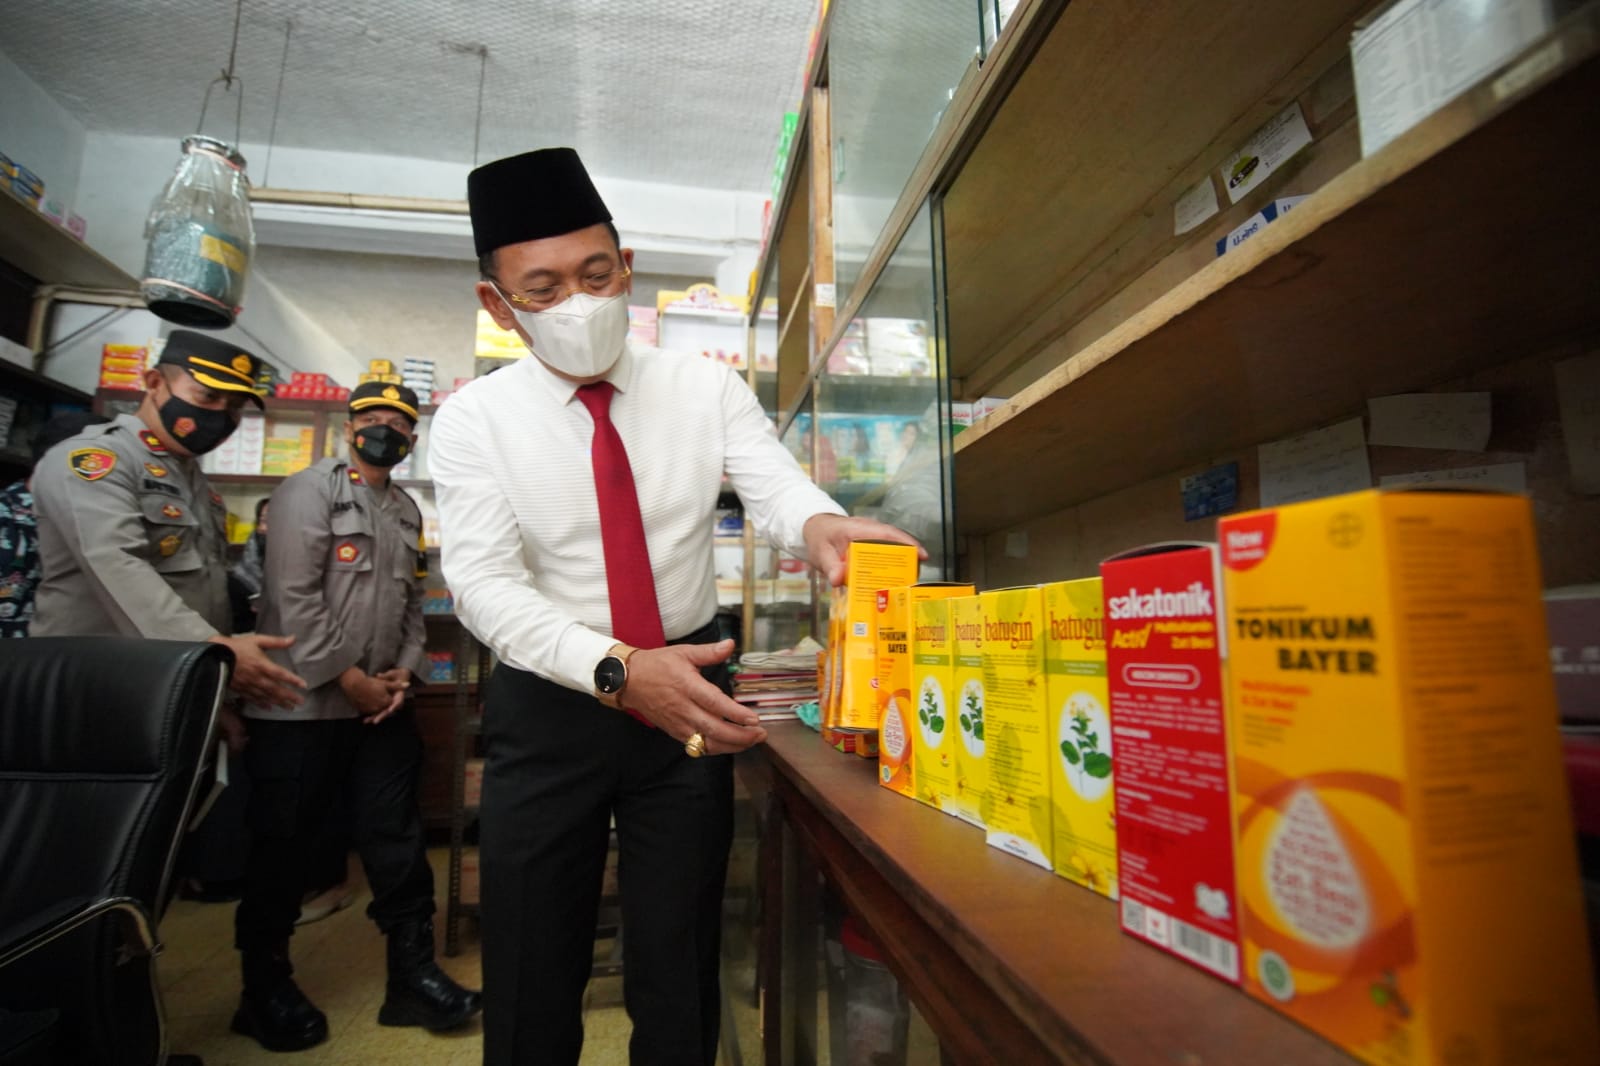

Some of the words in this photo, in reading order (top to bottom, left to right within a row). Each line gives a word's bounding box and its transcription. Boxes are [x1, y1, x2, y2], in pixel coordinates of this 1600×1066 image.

[1108, 581, 1213, 619] sakatonik
[984, 612, 1033, 650] batugin
[1235, 615, 1377, 643] TONIKUM
[1276, 648, 1379, 676] BAYER
